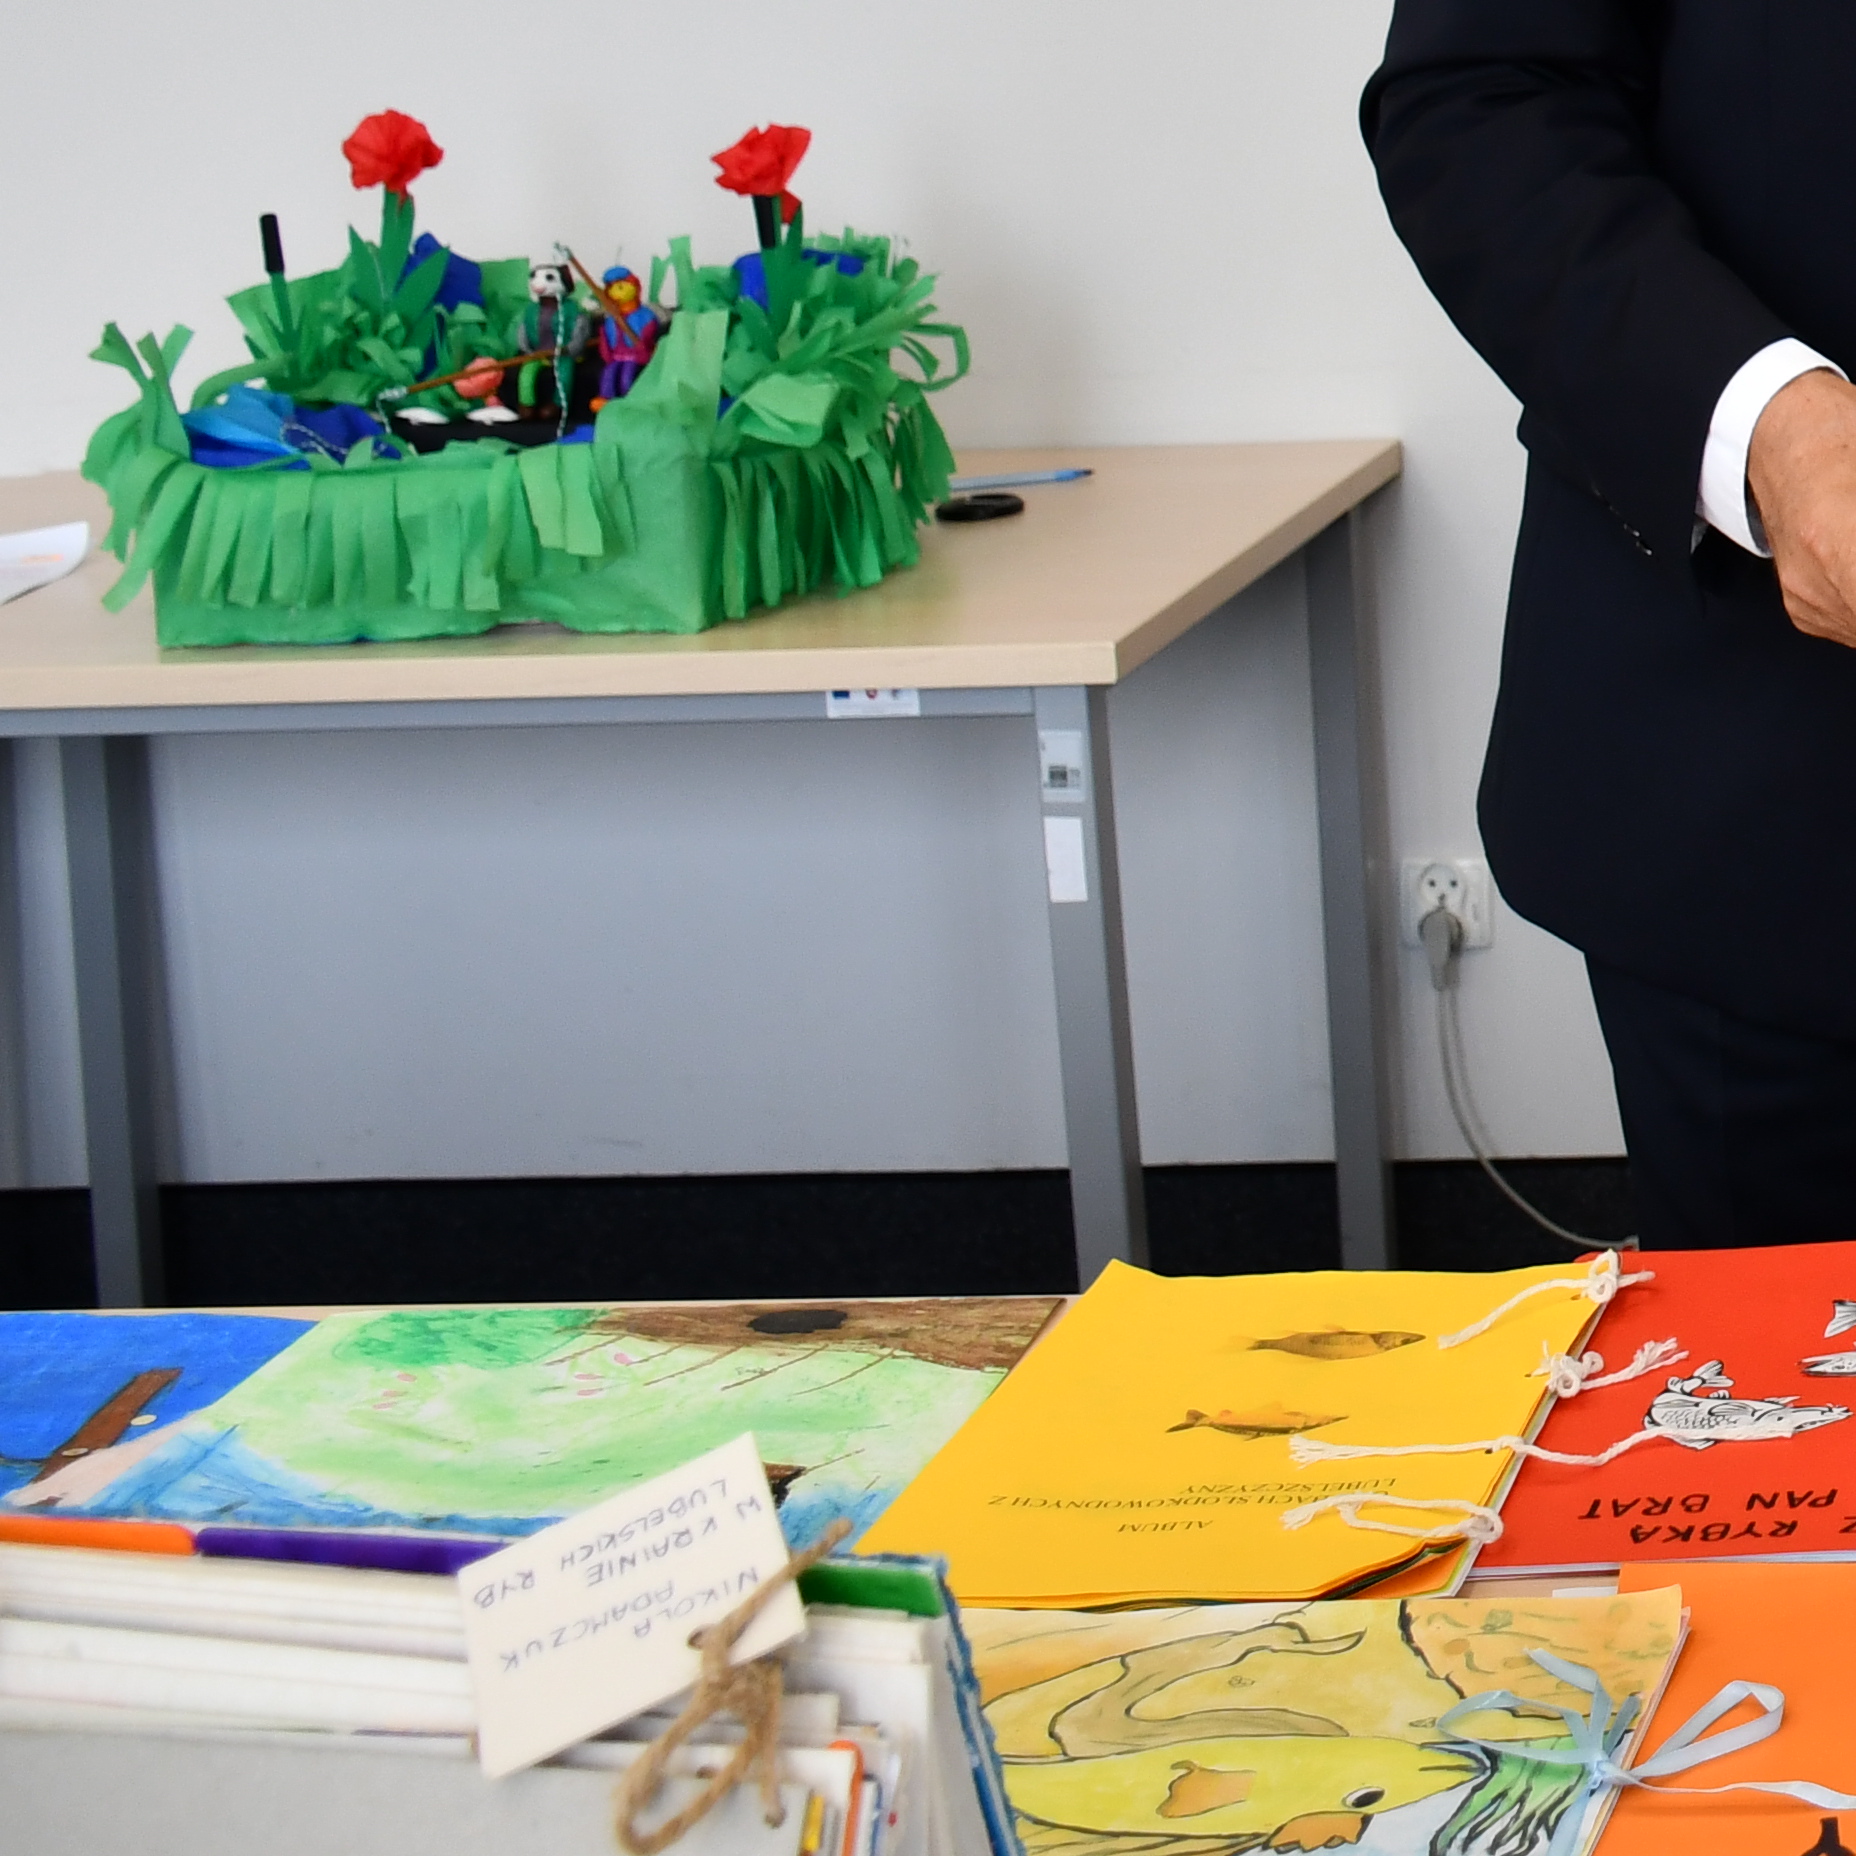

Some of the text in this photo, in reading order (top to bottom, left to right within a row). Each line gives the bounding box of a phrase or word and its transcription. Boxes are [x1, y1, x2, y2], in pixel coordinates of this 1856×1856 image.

[986, 1496, 1008, 1504] Z
[1180, 1478, 1396, 1493] LUBELSZCZYZNY
[1746, 1487, 1838, 1512] PAN
[1577, 1492, 1710, 1521] BRAT
[1118, 1520, 1213, 1532] ALBUM
[473, 1478, 726, 1610] LUBELSKICH RYB
[585, 1496, 760, 1587] W KRAINIE
[633, 1566, 760, 1638] NIKOLA
[499, 1579, 675, 1672] ADAMCZUK
